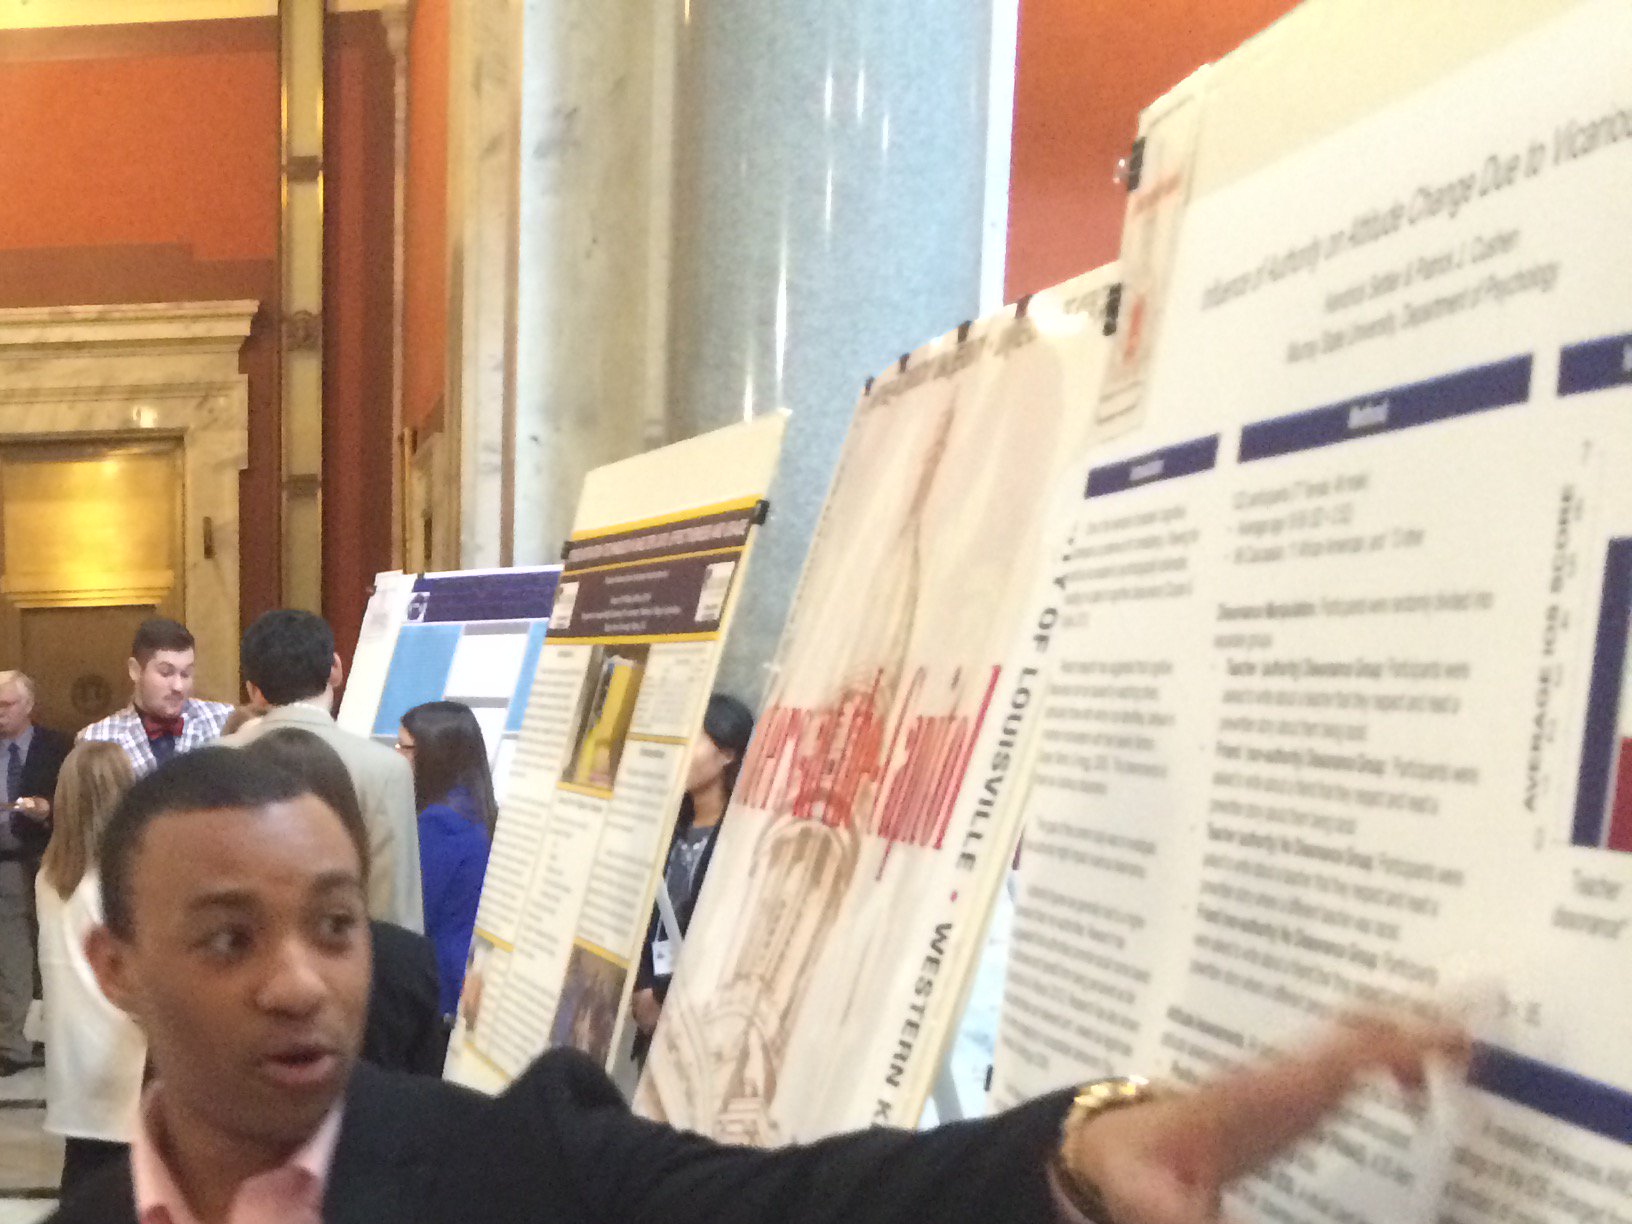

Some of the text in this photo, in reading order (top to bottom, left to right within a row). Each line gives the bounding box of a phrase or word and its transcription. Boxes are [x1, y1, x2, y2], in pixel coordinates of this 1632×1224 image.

[885, 606, 1059, 1088] OF LOUISVILLE WESTERN
